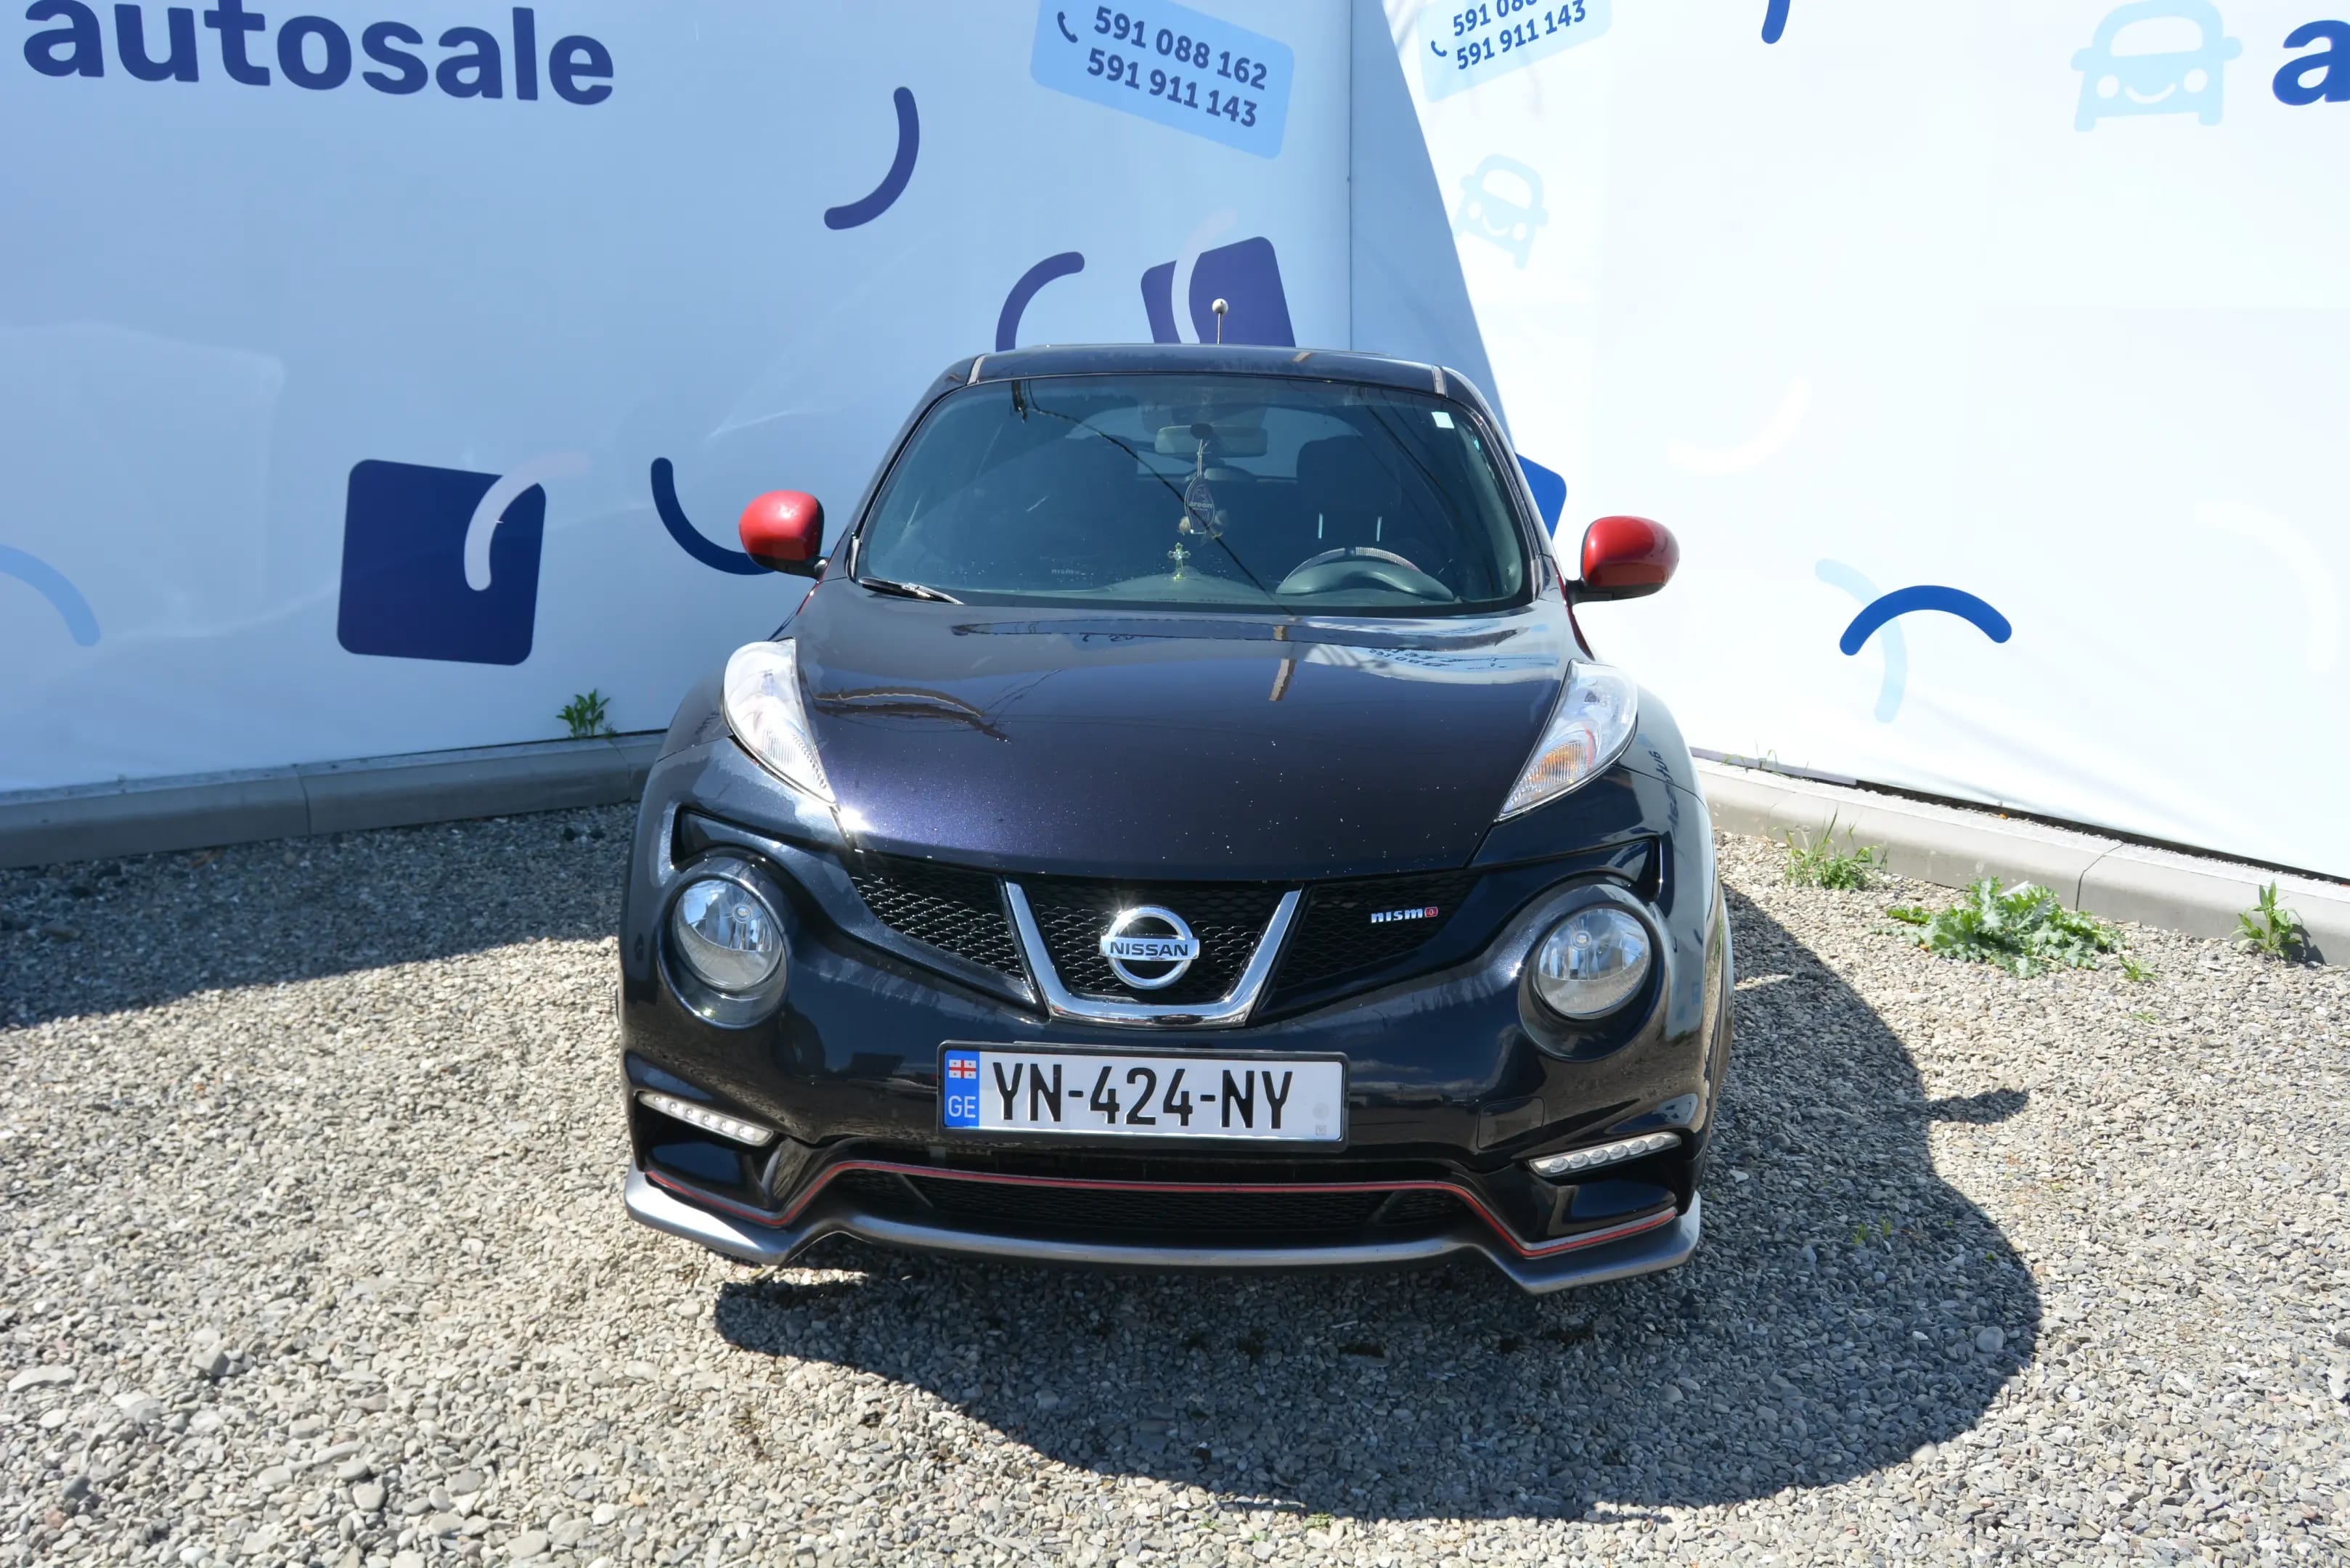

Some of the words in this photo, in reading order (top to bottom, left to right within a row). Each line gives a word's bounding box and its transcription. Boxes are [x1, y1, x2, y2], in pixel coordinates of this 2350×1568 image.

[23, 0, 614, 105] autosale
[1094, 5, 1146, 49] 591
[1156, 28, 1210, 69] 088
[1217, 51, 1268, 91] 162
[1453, 3, 1491, 37] 591
[1456, 36, 1496, 70] 591
[1499, 18, 1540, 53] 911
[1544, 0, 1586, 36] 143
[1087, 47, 1140, 90] 591
[1149, 69, 1199, 110] 911
[1206, 89, 1257, 128] 143
[1110, 942, 1189, 957] NISSAN
[1371, 907, 1439, 924] nismo
[948, 1095, 976, 1119] GE
[992, 1061, 1293, 1130] YN-424-NY
